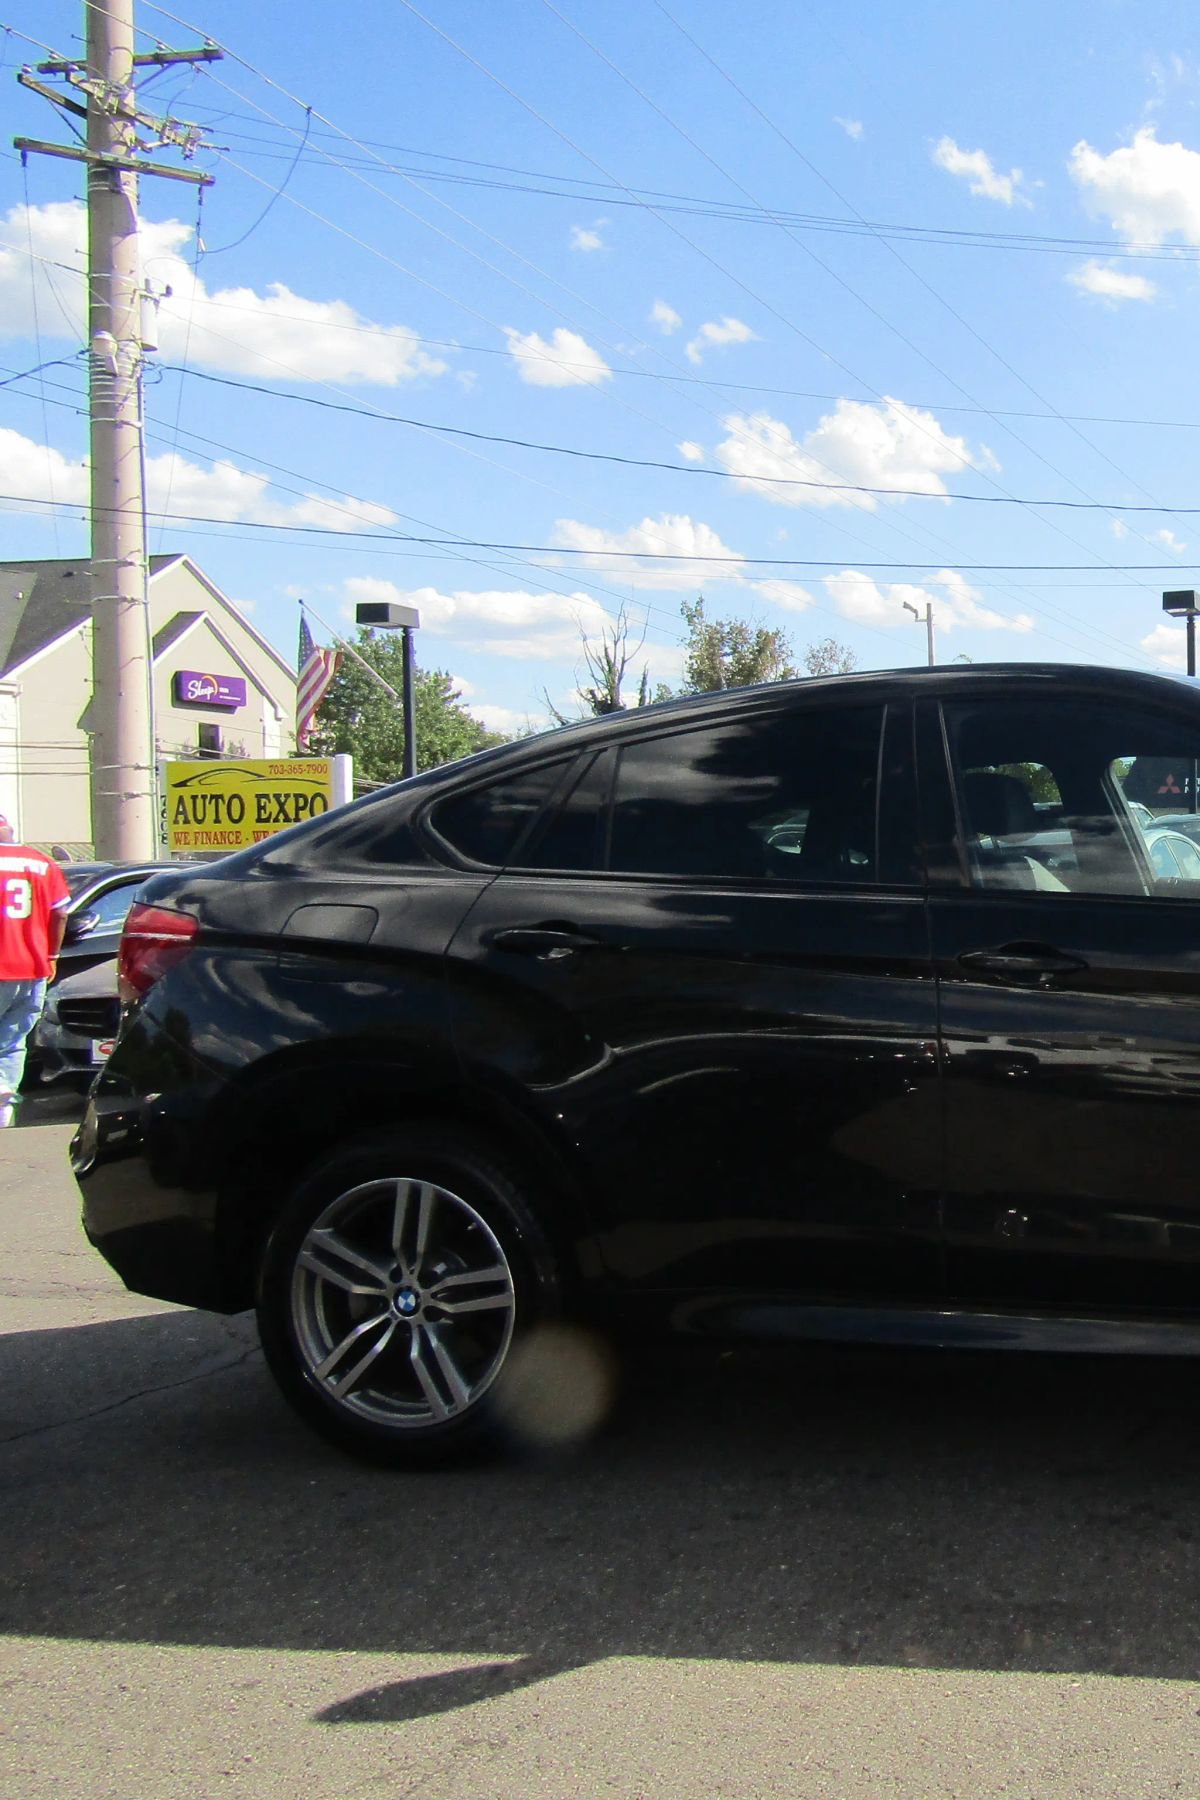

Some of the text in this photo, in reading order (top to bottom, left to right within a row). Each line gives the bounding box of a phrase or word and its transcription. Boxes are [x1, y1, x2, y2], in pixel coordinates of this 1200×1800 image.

[173, 792, 329, 825] AUTO EXPO
[174, 831, 190, 845] WE
[194, 830, 242, 845] FINANCE
[6, 879, 32, 918] 3
